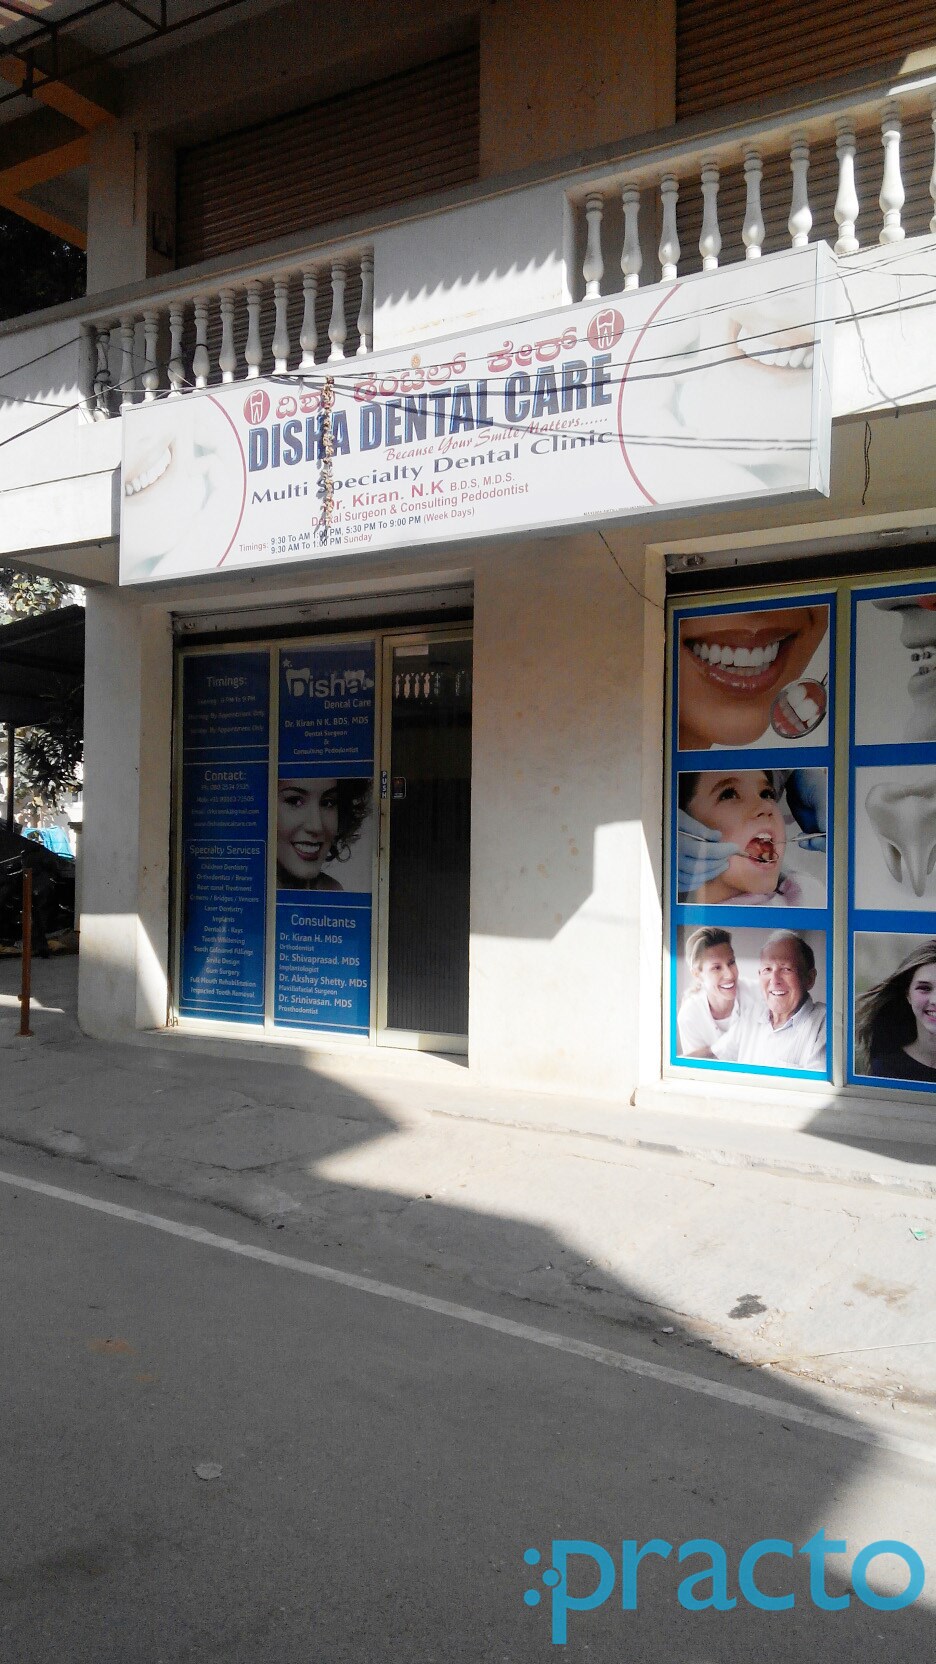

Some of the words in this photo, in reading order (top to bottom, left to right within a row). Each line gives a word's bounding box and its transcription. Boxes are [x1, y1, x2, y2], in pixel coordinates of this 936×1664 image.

[486, 327, 577, 372] ಕೇರ್
[249, 410, 351, 472] DISHA
[360, 379, 493, 451] DENTAL
[504, 353, 612, 422] CARE
[383, 446, 434, 461] Because
[437, 436, 472, 455] Your
[474, 426, 520, 448] Smile
[252, 482, 308, 504] Multi
[316, 465, 423, 495] Specialty
[434, 443, 519, 473] Dental
[530, 430, 612, 455] Clinic
[352, 491, 404, 507] Kiran.
[411, 480, 444, 498] N.K
[311, 513, 342, 526] Detal
[345, 508, 386, 522] Surgeon
[390, 505, 397, 514] &
[400, 495, 458, 512] Consulting
[462, 483, 529, 502] Pedodontist
[288, 534, 296, 542] To
[298, 532, 310, 540] AM
[346, 525, 362, 533] 5:30
[363, 522, 376, 532] PM
[378, 520, 387, 529] To
[389, 518, 406, 527] 9:00
[408, 515, 421, 525] PM
[423, 511, 448, 524] (Week
[450, 506, 475, 519] Days)
[239, 542, 269, 553] Timings:
[288, 543, 300, 552] AM
[302, 541, 310, 549] To
[313, 539, 327, 548] 1:00
[329, 537, 341, 546] PM
[343, 533, 373, 544] Sunday
[206, 676, 248, 689] Timings:
[324, 699, 350, 709] Dental
[352, 698, 371, 708] Care
[285, 720, 295, 728] Dr.
[296, 719, 315, 727] Kiran
[351, 716, 369, 724] MDS
[204, 770, 247, 781] Contact:
[189, 845, 225, 857] Specialty
[226, 845, 261, 855] Services
[291, 914, 357, 929] Consultants
[280, 932, 290, 941] Dr.
[292, 933, 312, 942] Kiran
[324, 935, 343, 944] MDS
[279, 943, 315, 952] Orthodontist
[279, 953, 290, 961] Dr.
[341, 956, 361, 966] MDS
[279, 973, 290, 982] Dr.
[291, 974, 318, 986] Akshay
[348, 978, 368, 988] MDS
[314, 987, 338, 996] Surgeon
[278, 993, 289, 1002] Dr.
[334, 999, 352, 1008] MDS
[278, 1004, 319, 1014] Prosthodontist
